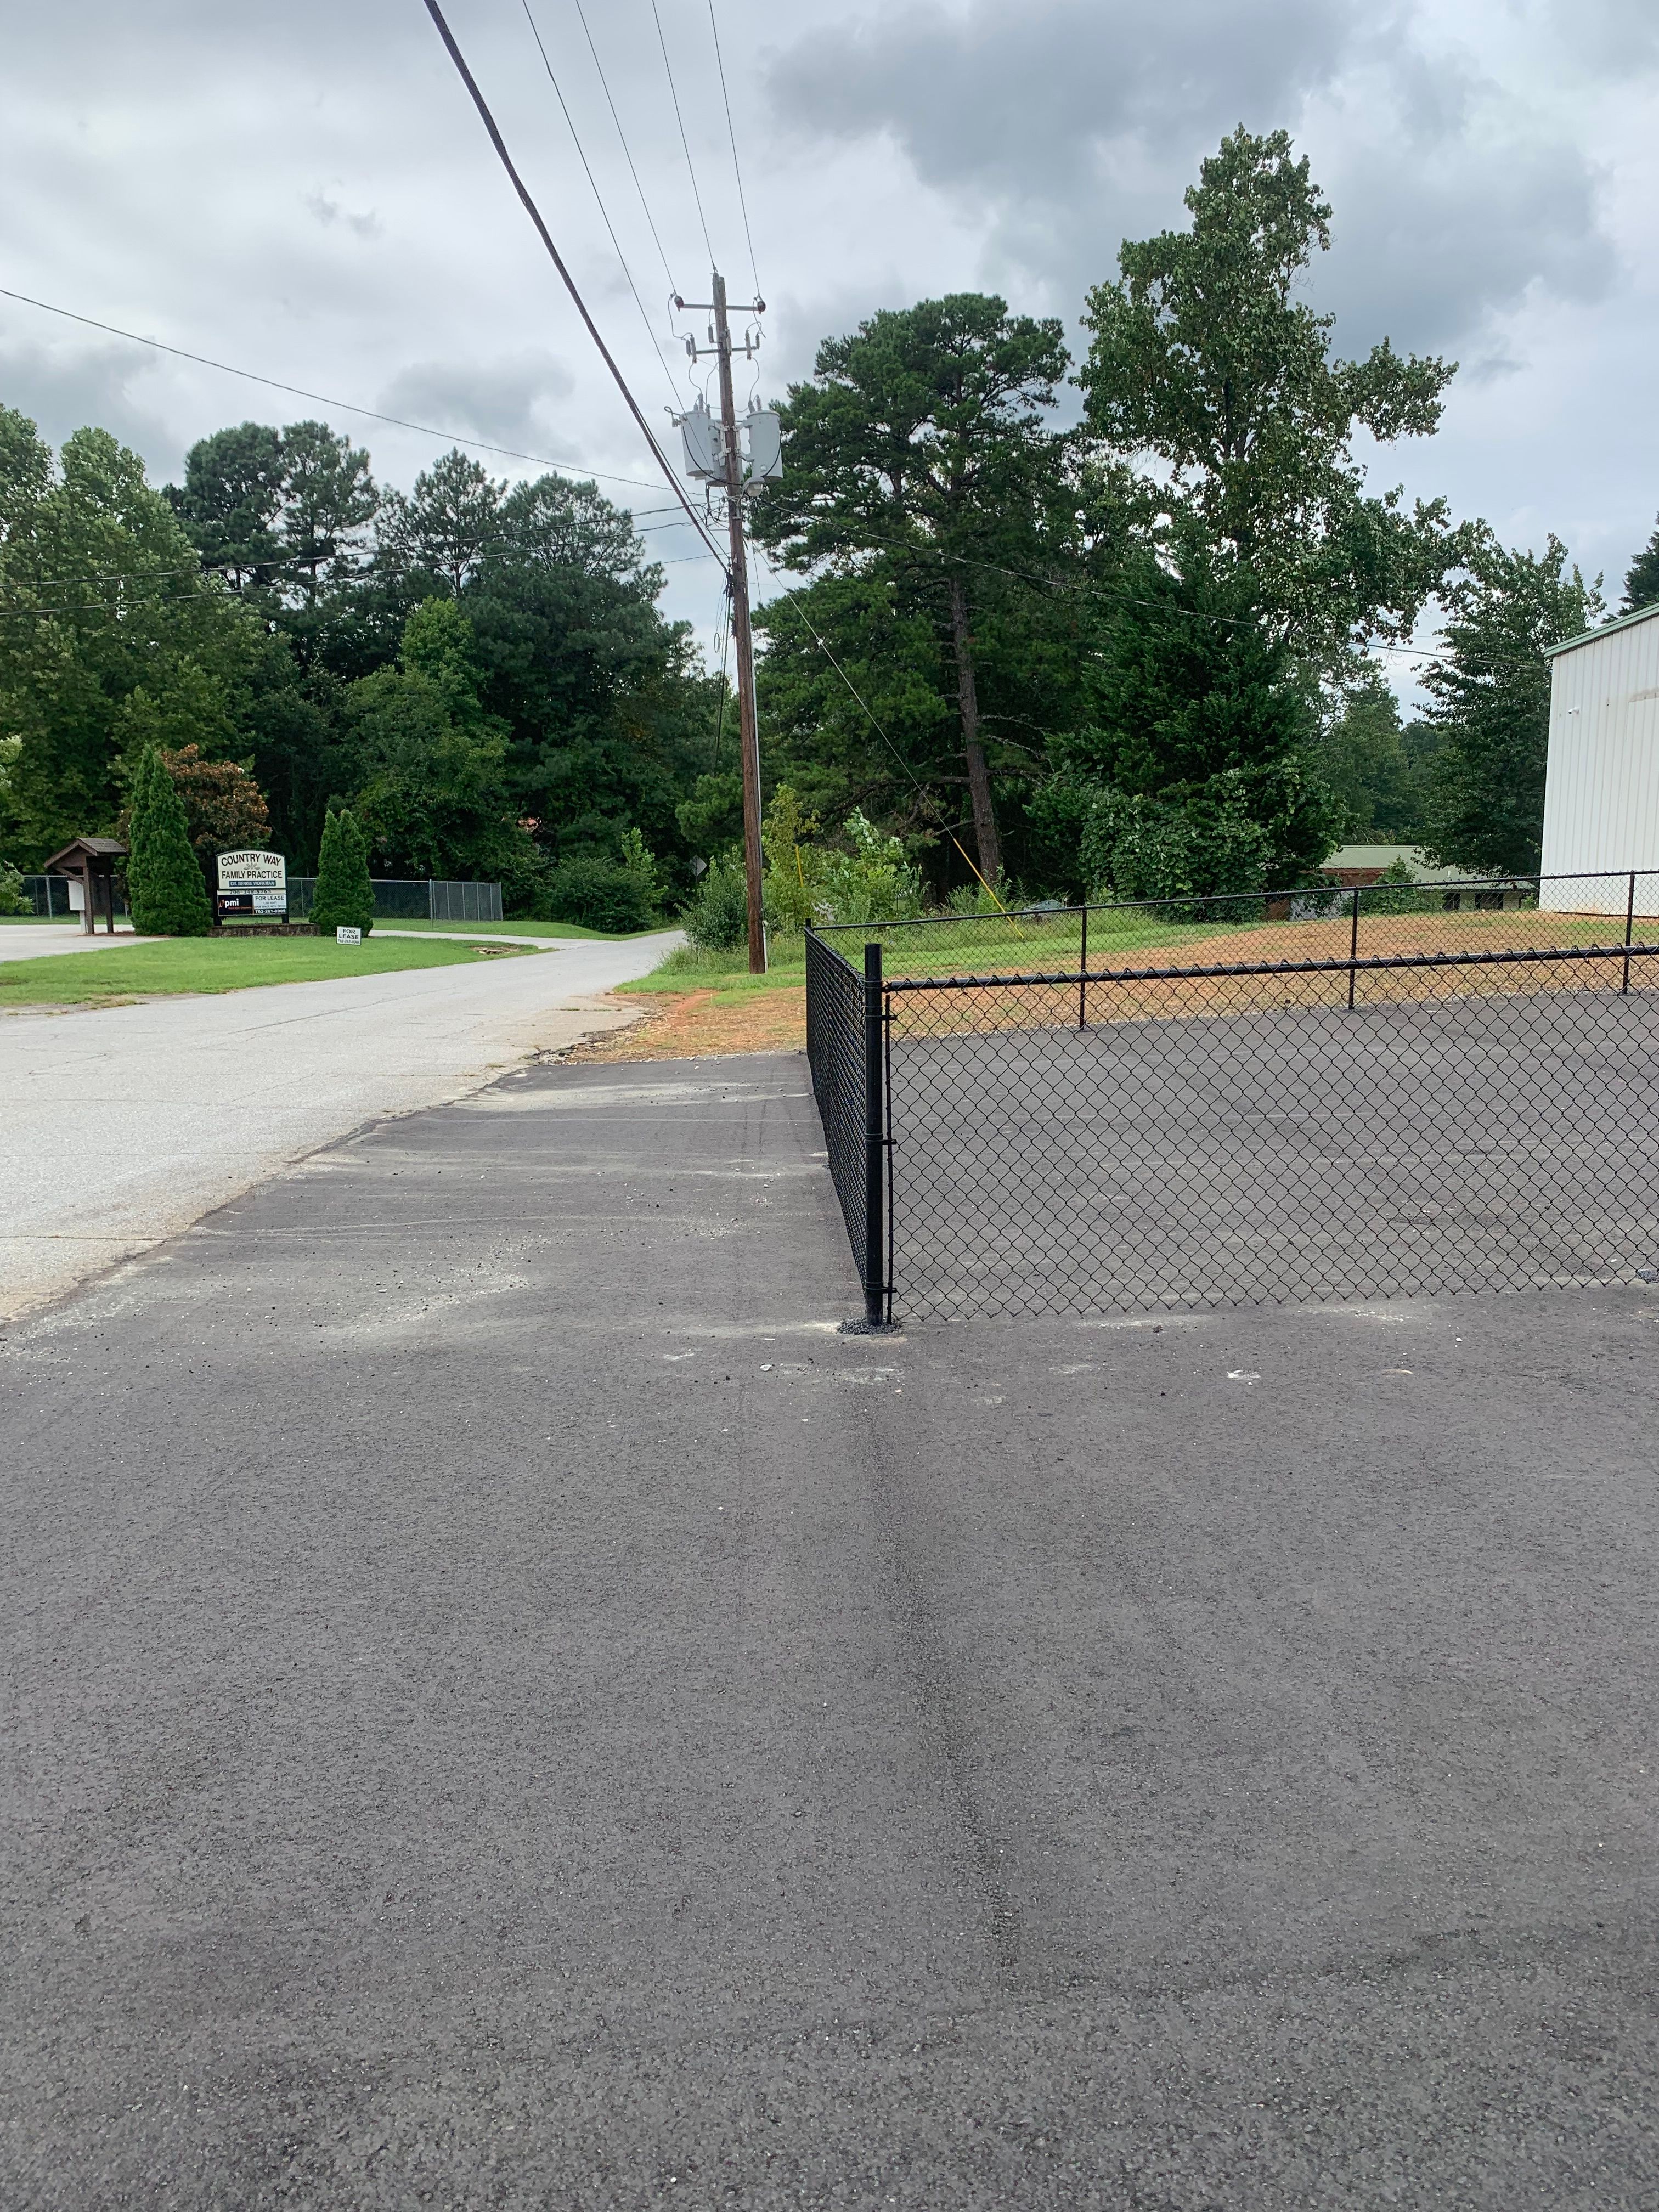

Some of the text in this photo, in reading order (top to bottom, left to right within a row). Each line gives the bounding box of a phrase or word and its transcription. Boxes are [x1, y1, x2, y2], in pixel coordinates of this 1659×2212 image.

[221, 854, 281, 866] COUNTRY WAY
[222, 870, 282, 879] FAMILY PRACTICE
[224, 898, 239, 908] pmi
